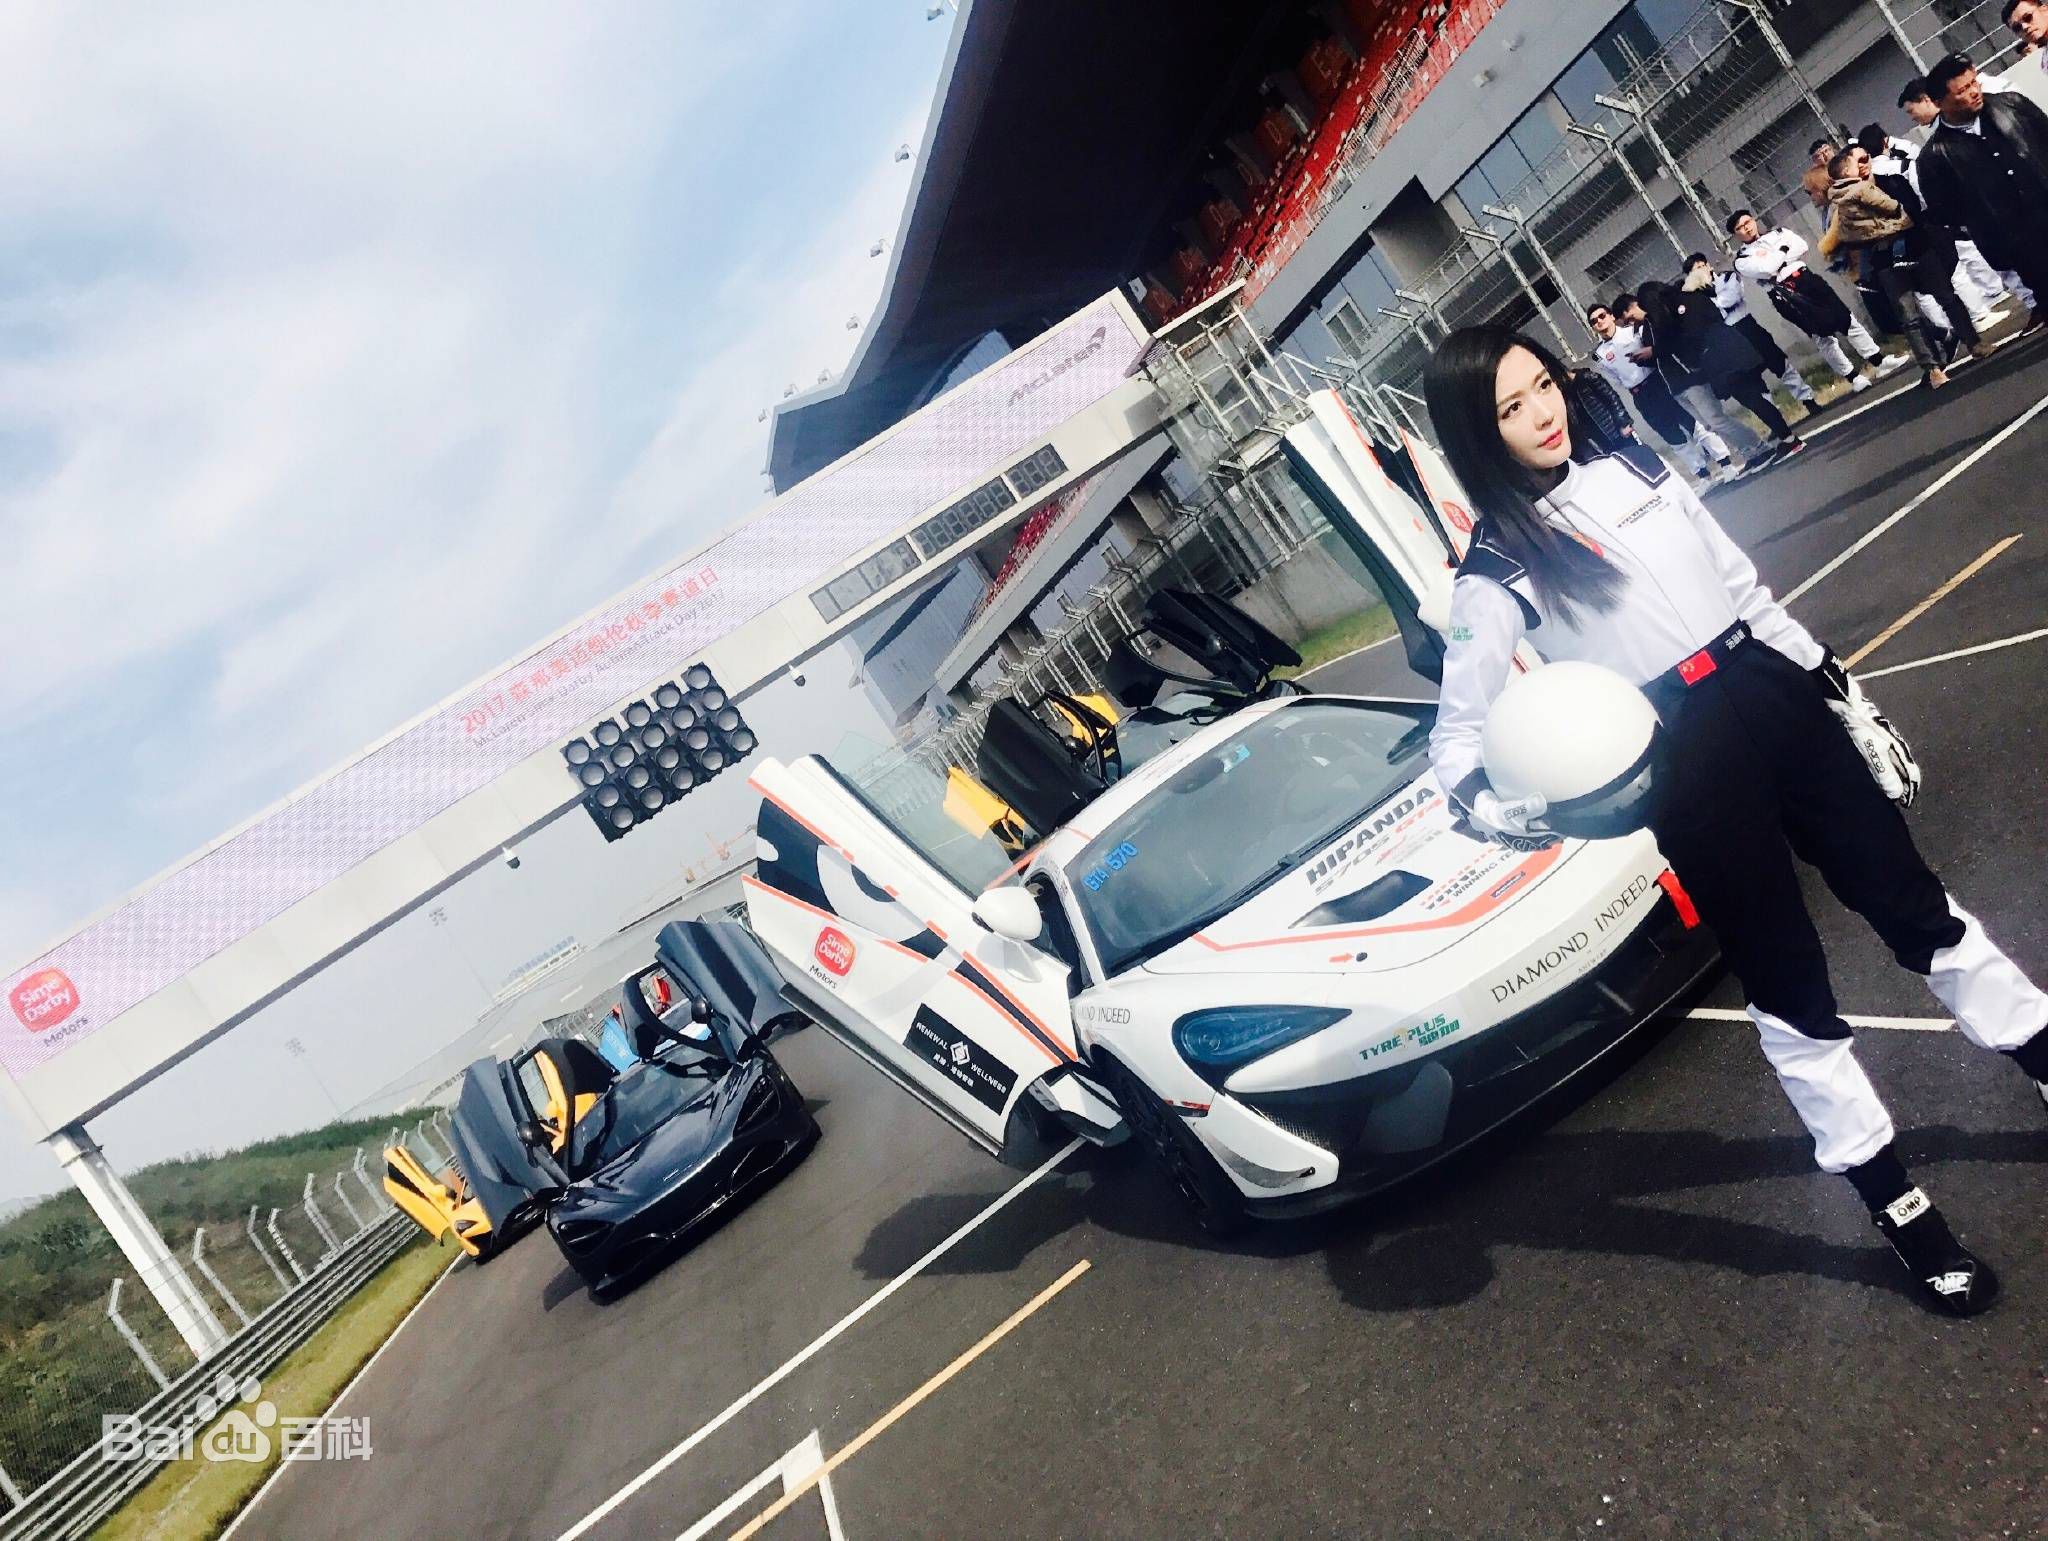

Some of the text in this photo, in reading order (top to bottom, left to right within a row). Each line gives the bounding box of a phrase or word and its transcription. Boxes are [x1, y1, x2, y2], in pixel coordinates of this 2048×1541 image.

[461, 695, 508, 734] 2017
[1305, 787, 1436, 886] HIPANDA
[826, 932, 851, 956] Sime
[1489, 931, 1590, 1003] DIAMOND
[1594, 874, 1648, 932] INDEED
[818, 942, 849, 970] Darby
[809, 964, 838, 990] Motors
[1098, 1007, 1131, 1024] INDEED
[43, 1016, 89, 1047] Motors
[1898, 1196, 1921, 1217] OMP
